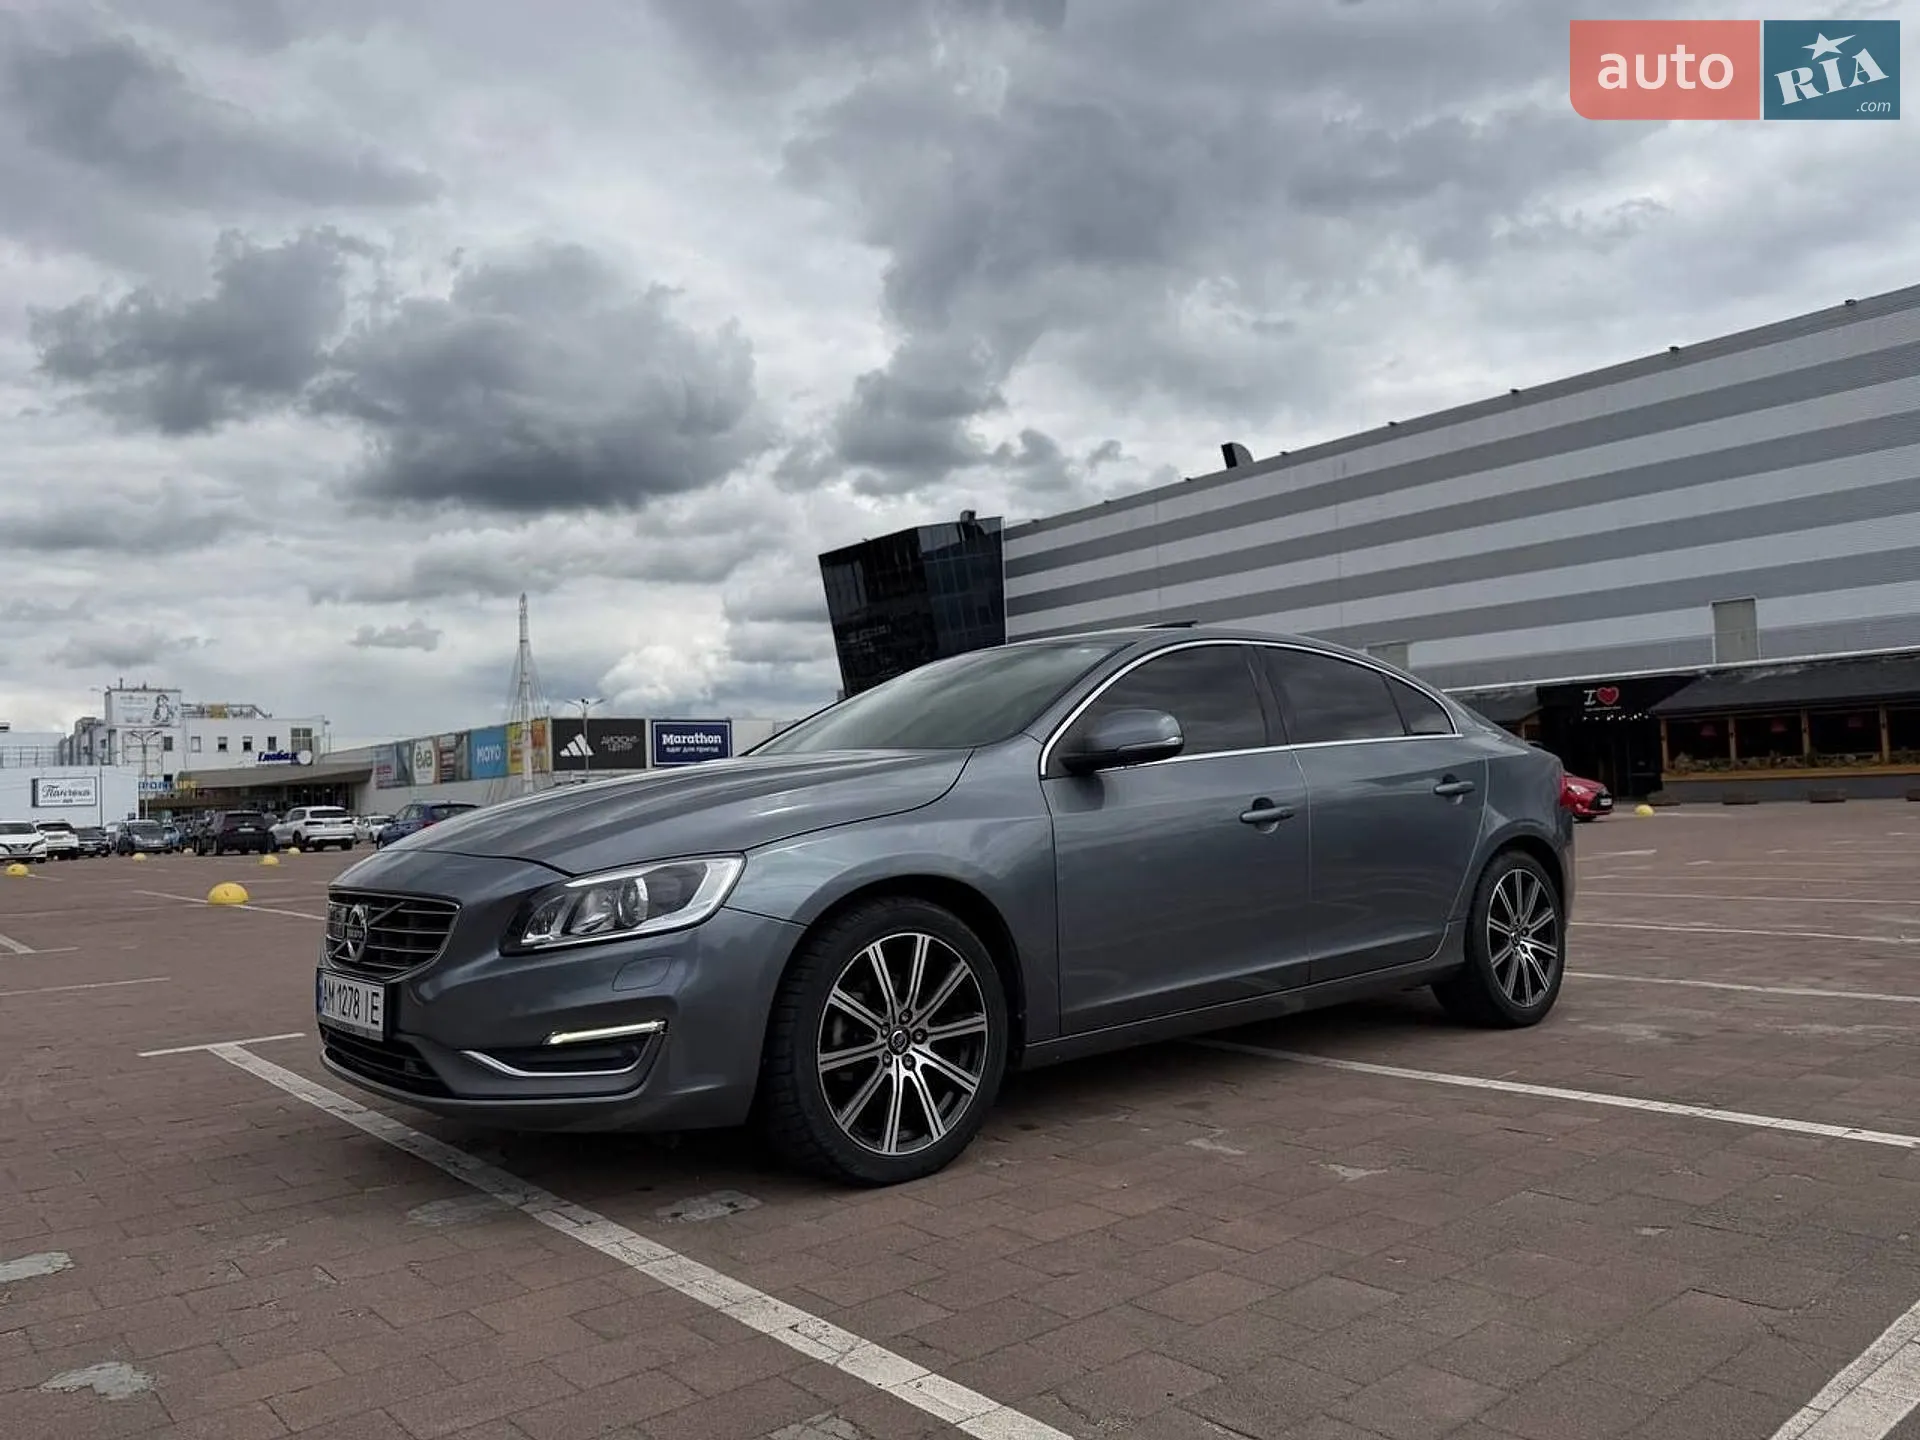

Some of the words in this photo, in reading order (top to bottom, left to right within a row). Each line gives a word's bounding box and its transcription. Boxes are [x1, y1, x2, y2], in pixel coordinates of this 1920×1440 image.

[661, 732, 721, 745] Marathon
[323, 978, 337, 1014] AM
[337, 983, 360, 1020] 1278
[364, 989, 380, 1025] IE
